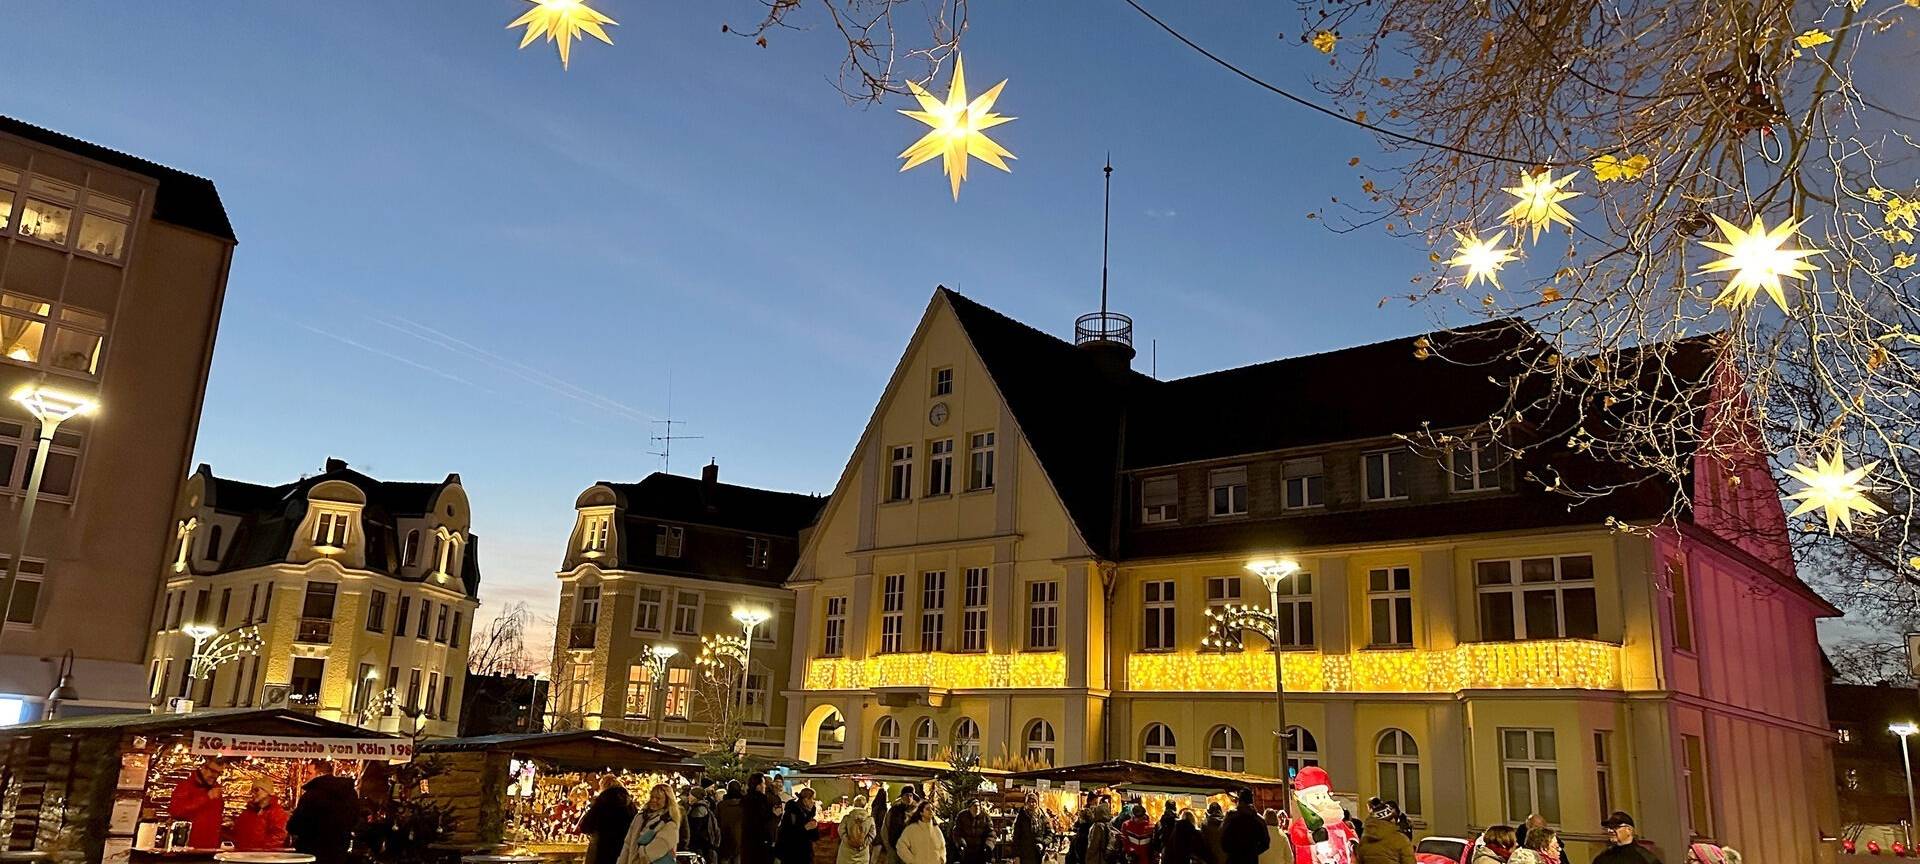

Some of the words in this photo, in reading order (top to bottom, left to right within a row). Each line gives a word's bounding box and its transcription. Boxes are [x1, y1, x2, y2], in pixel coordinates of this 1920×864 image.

[199, 736, 226, 750] KG.
[328, 744, 353, 754] von
[357, 743, 386, 755] Köln
